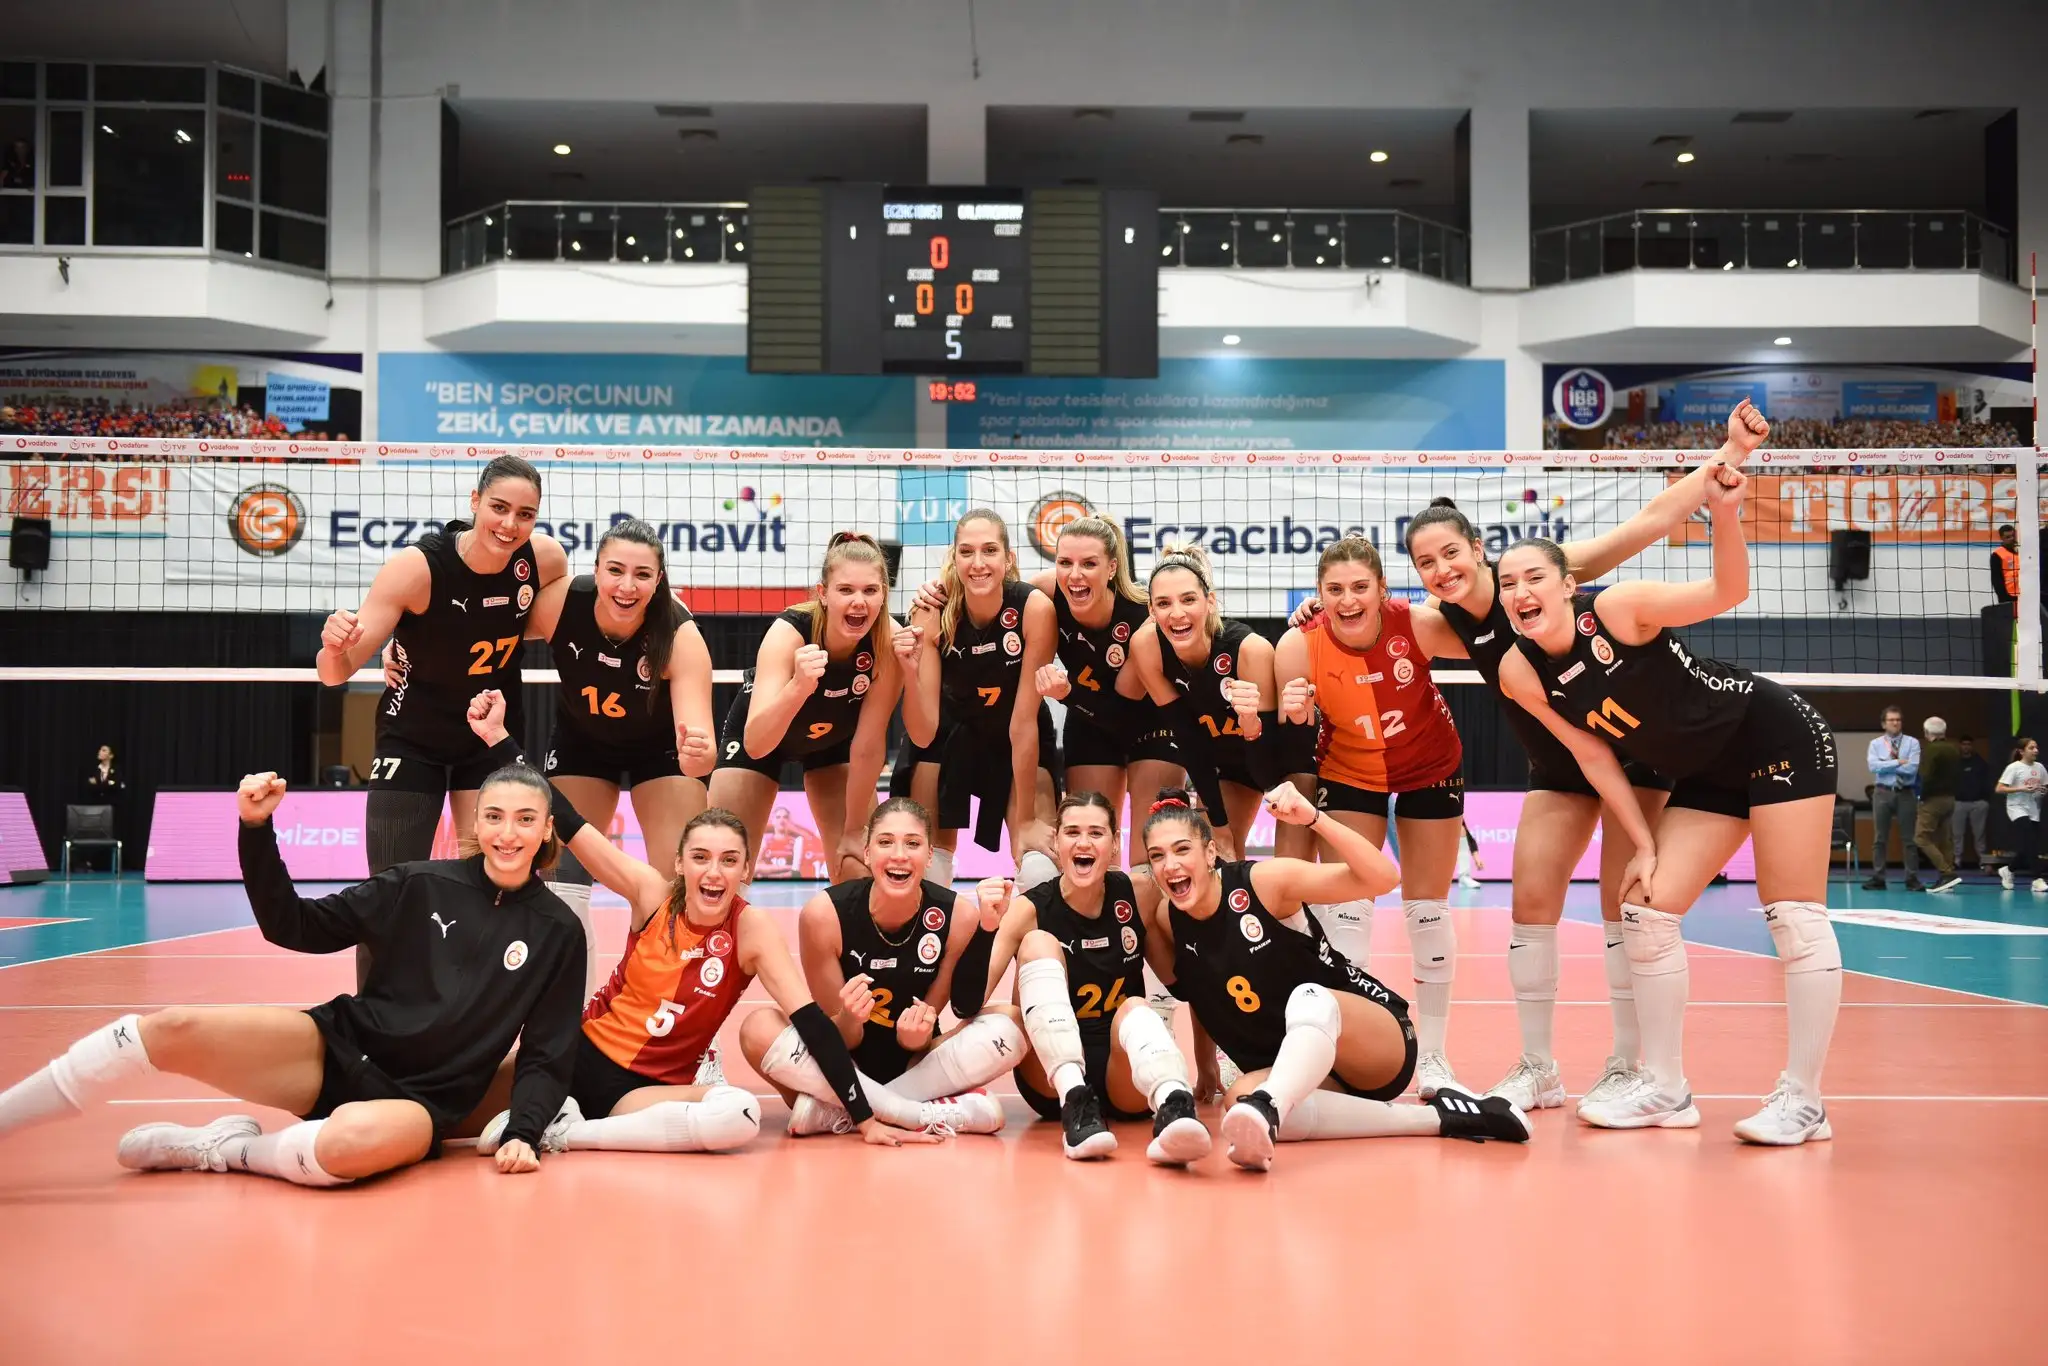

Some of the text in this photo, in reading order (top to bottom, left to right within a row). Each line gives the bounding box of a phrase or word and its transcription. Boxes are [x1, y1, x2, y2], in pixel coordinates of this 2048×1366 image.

[930, 236, 949, 269] 0
[916, 283, 934, 315] 0
[955, 283, 973, 315] 0
[945, 329, 962, 360] 5
[500, 383, 672, 406] SPORCUNUN
[436, 406, 843, 439] ZEKİ, ÇEVİK VE AYNI ZAMANDA
[610, 511, 786, 553] navit
[468, 635, 519, 676] 27
[1077, 665, 1100, 692] 4
[581, 685, 627, 718] 16
[977, 686, 1001, 707] 7
[806, 722, 834, 739] 9
[1198, 714, 1244, 738] 14
[1354, 709, 1407, 740] 12
[1587, 696, 1641, 739] 11
[1792, 693, 1835, 768] KAYAKAPI
[725, 740, 741, 760] 9
[369, 757, 402, 780] 27
[1075, 978, 1128, 1019] 24
[1226, 975, 1260, 1013] 8
[646, 1001, 686, 1037] 5
